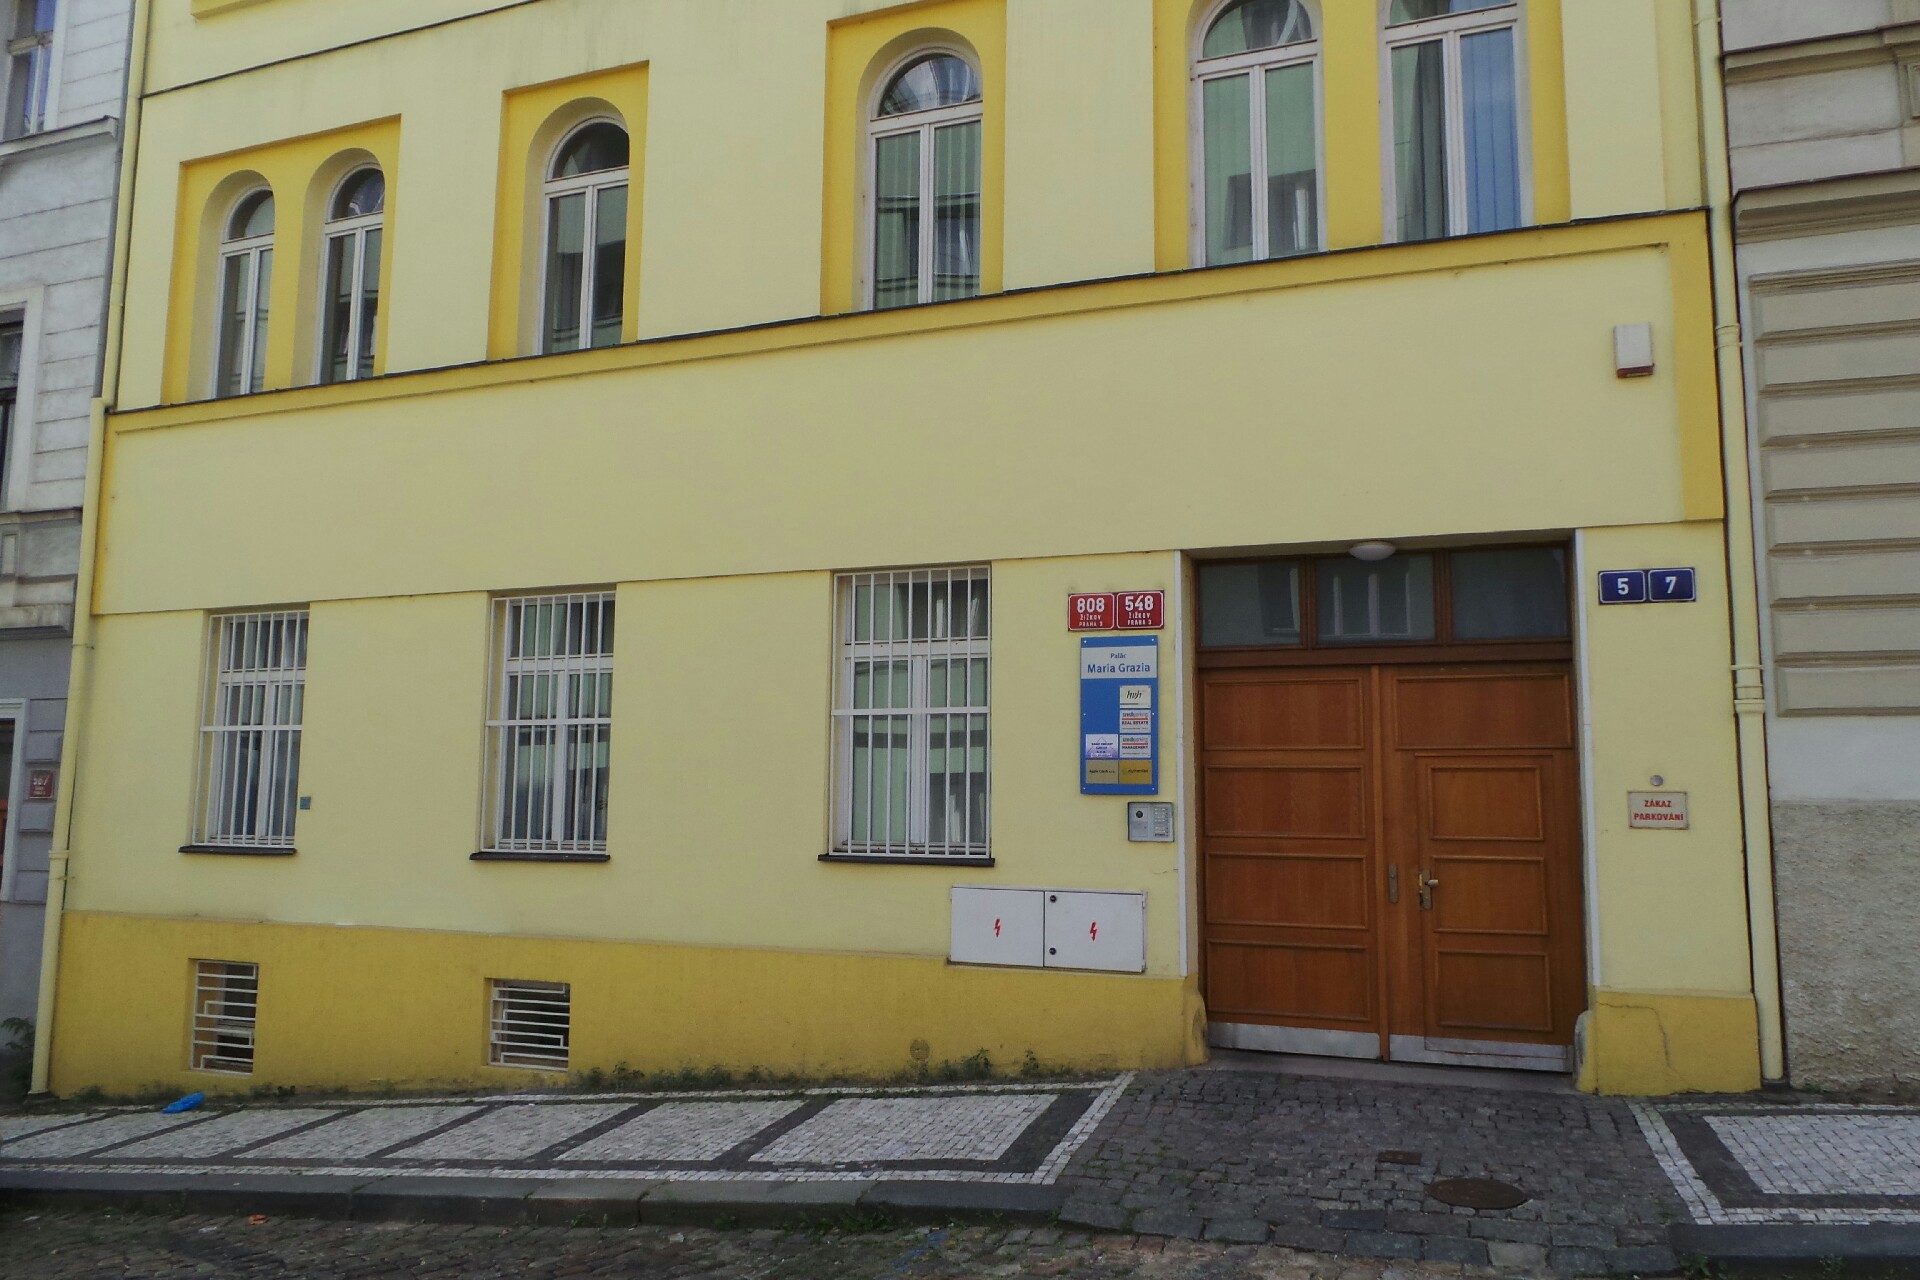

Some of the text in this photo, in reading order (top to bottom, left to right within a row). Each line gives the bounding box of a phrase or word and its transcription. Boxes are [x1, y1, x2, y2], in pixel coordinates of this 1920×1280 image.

[1617, 577, 1629, 595] 5
[1664, 576, 1677, 594] 7
[1077, 597, 1105, 613] 808
[1125, 595, 1154, 611] 548
[1087, 663, 1151, 674] Maria Grazia
[1644, 798, 1672, 808] ZÁKAZ
[1634, 812, 1684, 821] PARKOVÁNÍ
